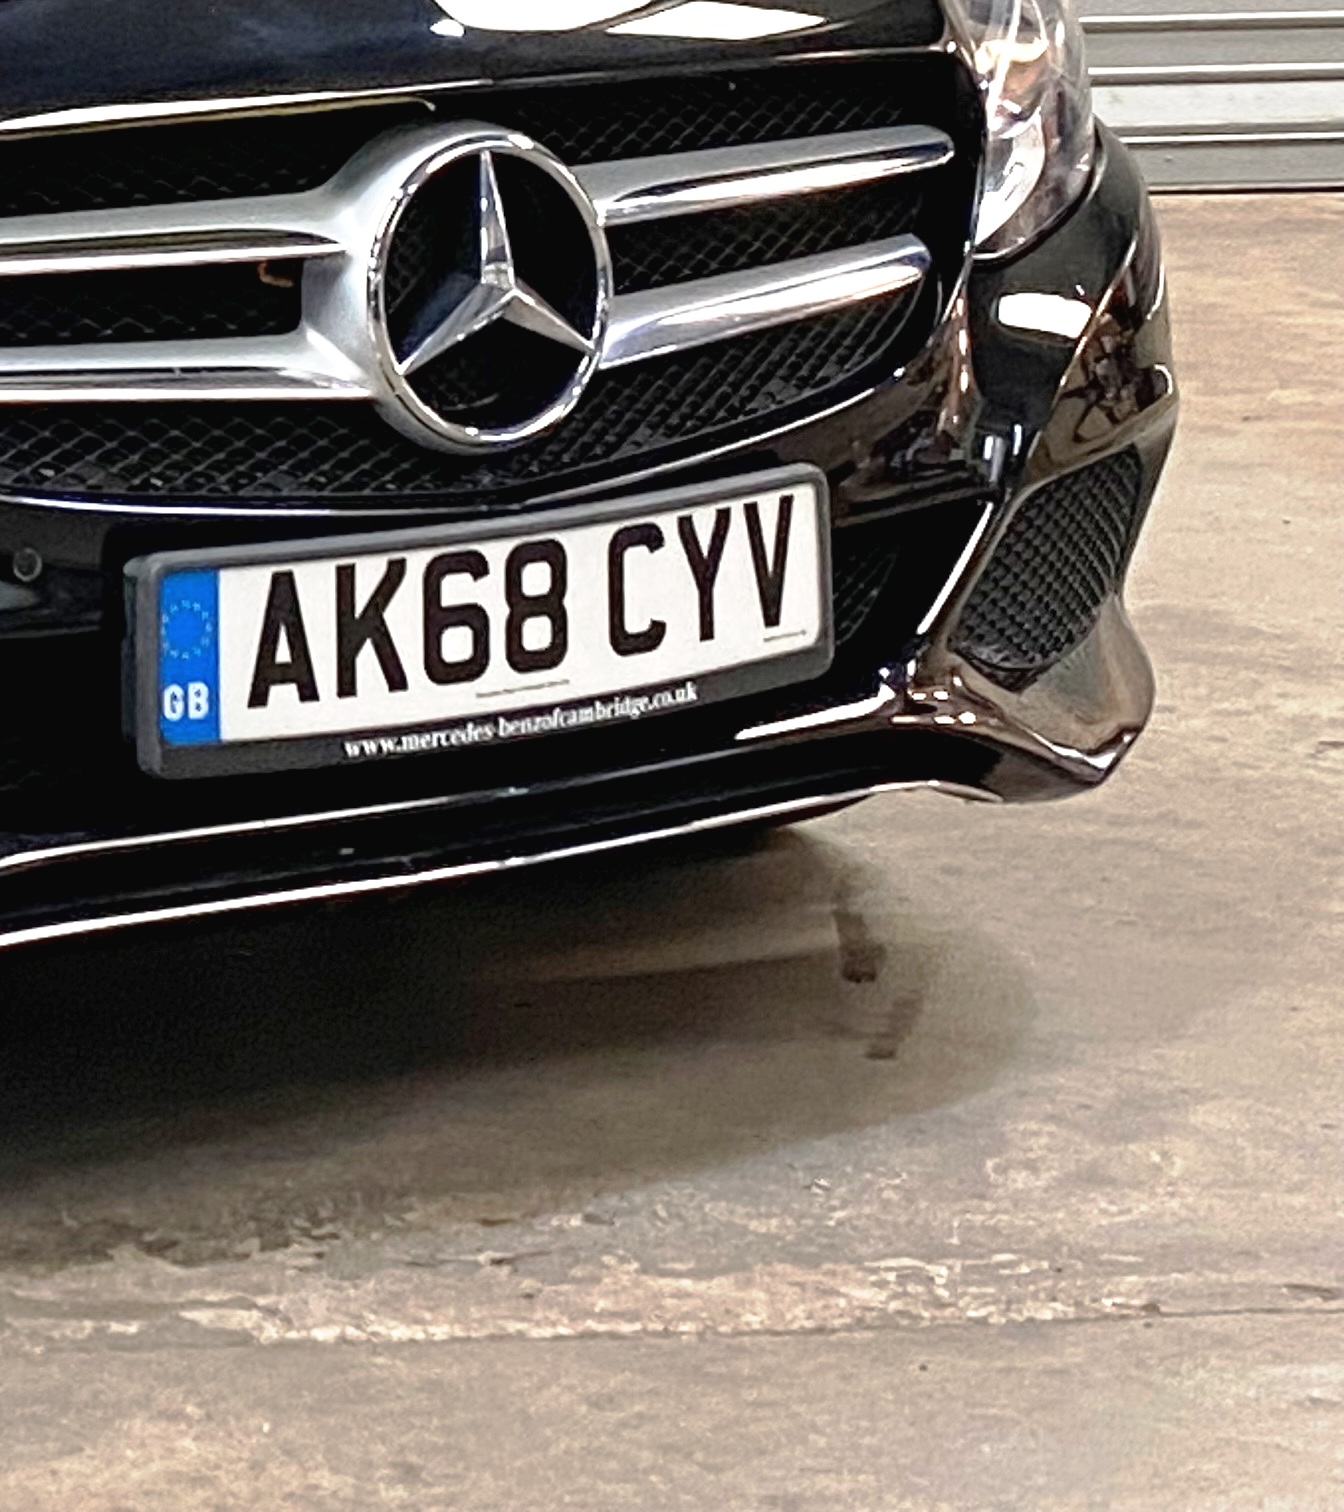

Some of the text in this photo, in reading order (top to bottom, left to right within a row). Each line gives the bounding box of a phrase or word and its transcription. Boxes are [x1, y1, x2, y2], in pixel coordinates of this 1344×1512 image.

[247, 494, 794, 709] AK68 CYV
[162, 681, 210, 722] GB
